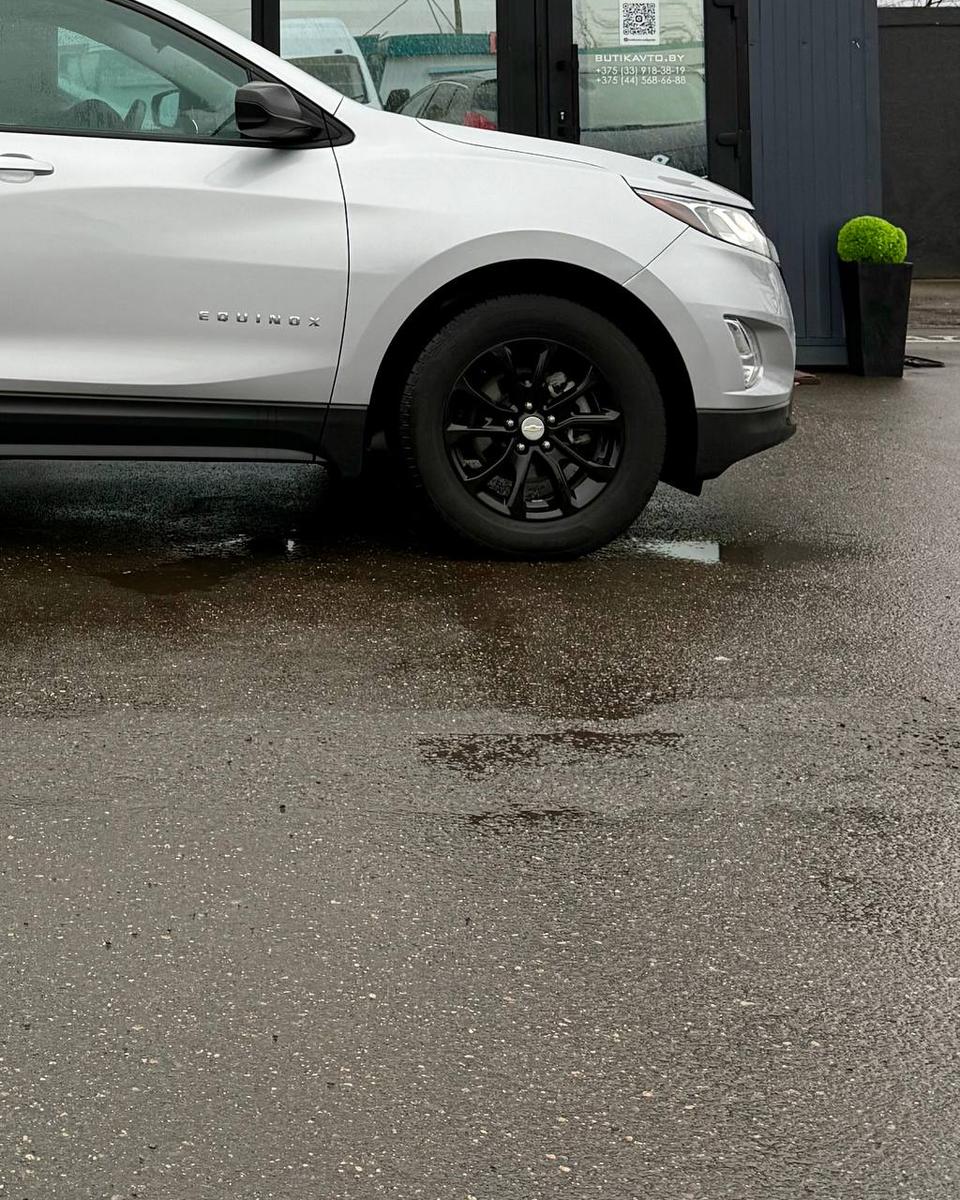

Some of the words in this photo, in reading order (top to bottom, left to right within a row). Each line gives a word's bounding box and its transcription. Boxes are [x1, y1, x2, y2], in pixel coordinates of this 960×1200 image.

[594, 54, 685, 62] BUTIKAVTO.BY
[596, 66, 618, 75] +375
[620, 66, 638, 76] (33)
[640, 66, 686, 75] 918-38-19
[596, 75, 618, 85] +375
[620, 75, 638, 86] (44)
[198, 310, 321, 327] EQUINOX
